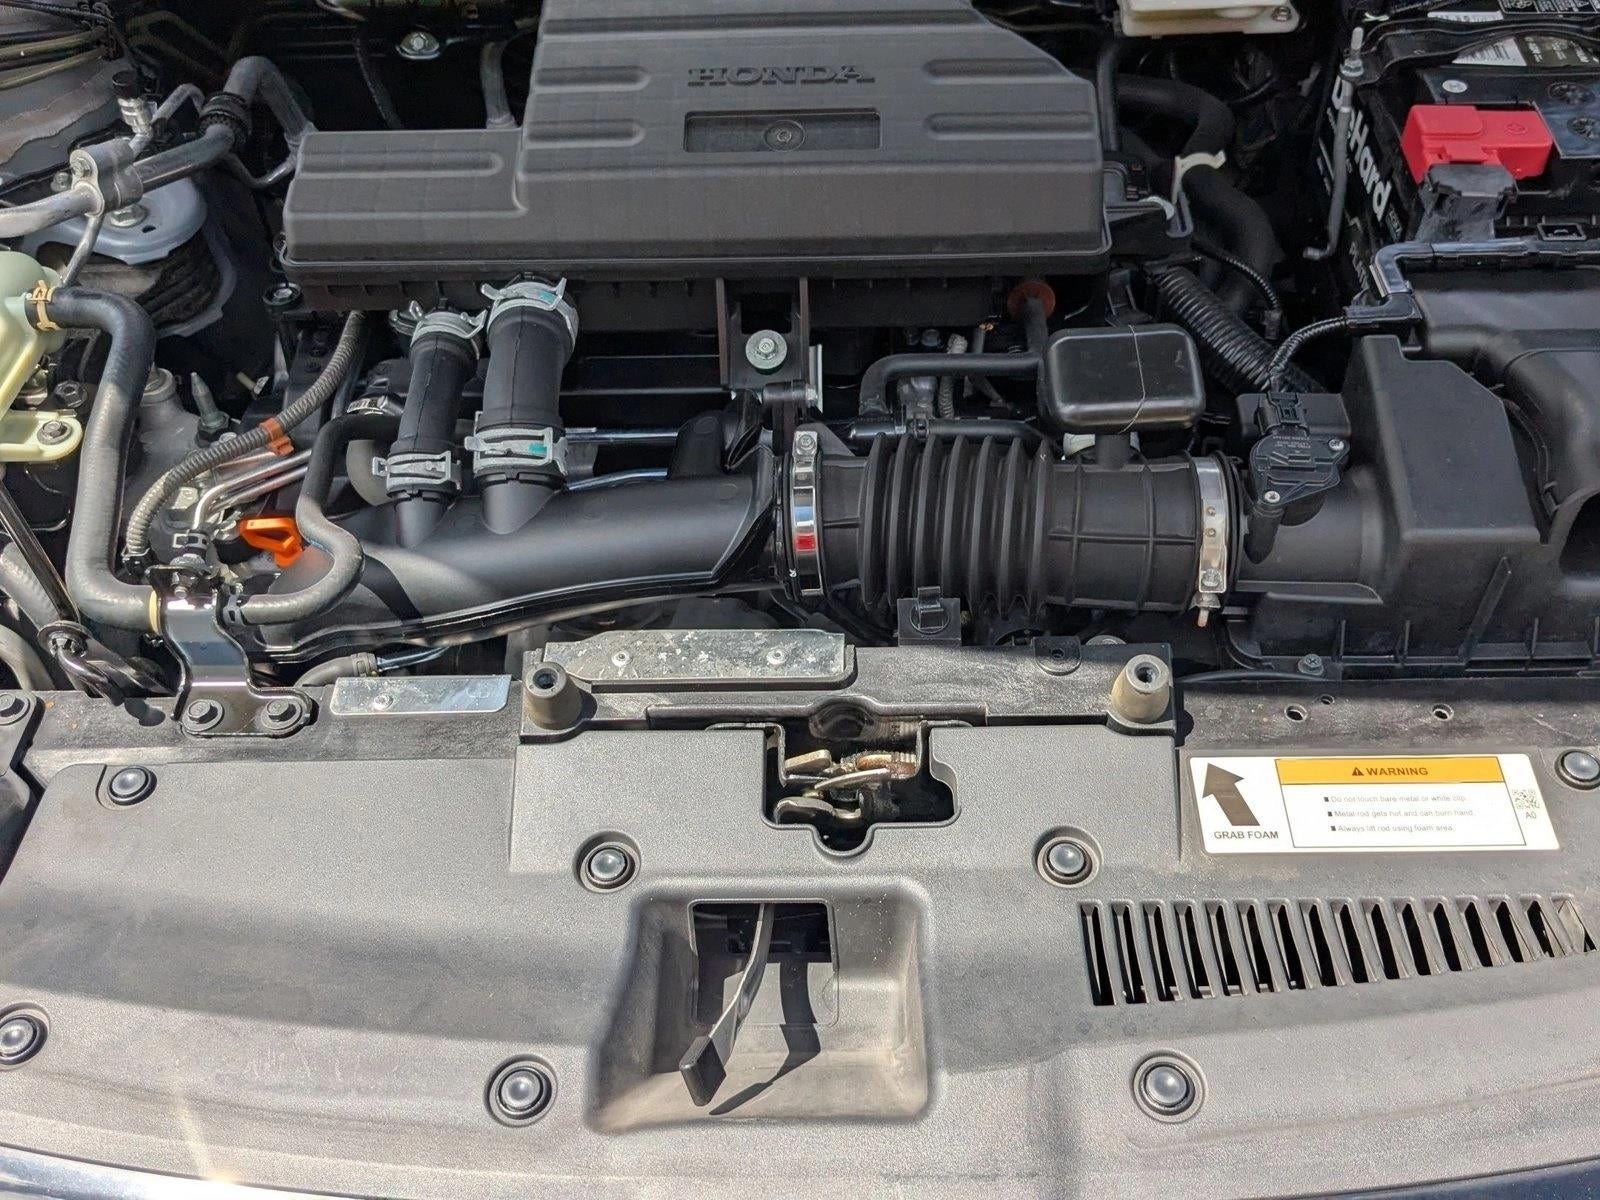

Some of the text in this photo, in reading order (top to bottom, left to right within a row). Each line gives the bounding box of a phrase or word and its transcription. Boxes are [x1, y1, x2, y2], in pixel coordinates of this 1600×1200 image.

[687, 65, 875, 86] HONDA
[1365, 767, 1429, 776] WARNING
[1380, 795, 1397, 803] bare
[1371, 811, 1388, 819] gets
[1434, 809, 1453, 817] burn
[1337, 825, 1365, 833] Always
[1392, 825, 1414, 834] using
[1414, 824, 1434, 832] foam
[1213, 830, 1280, 839] GRAB FOAM
